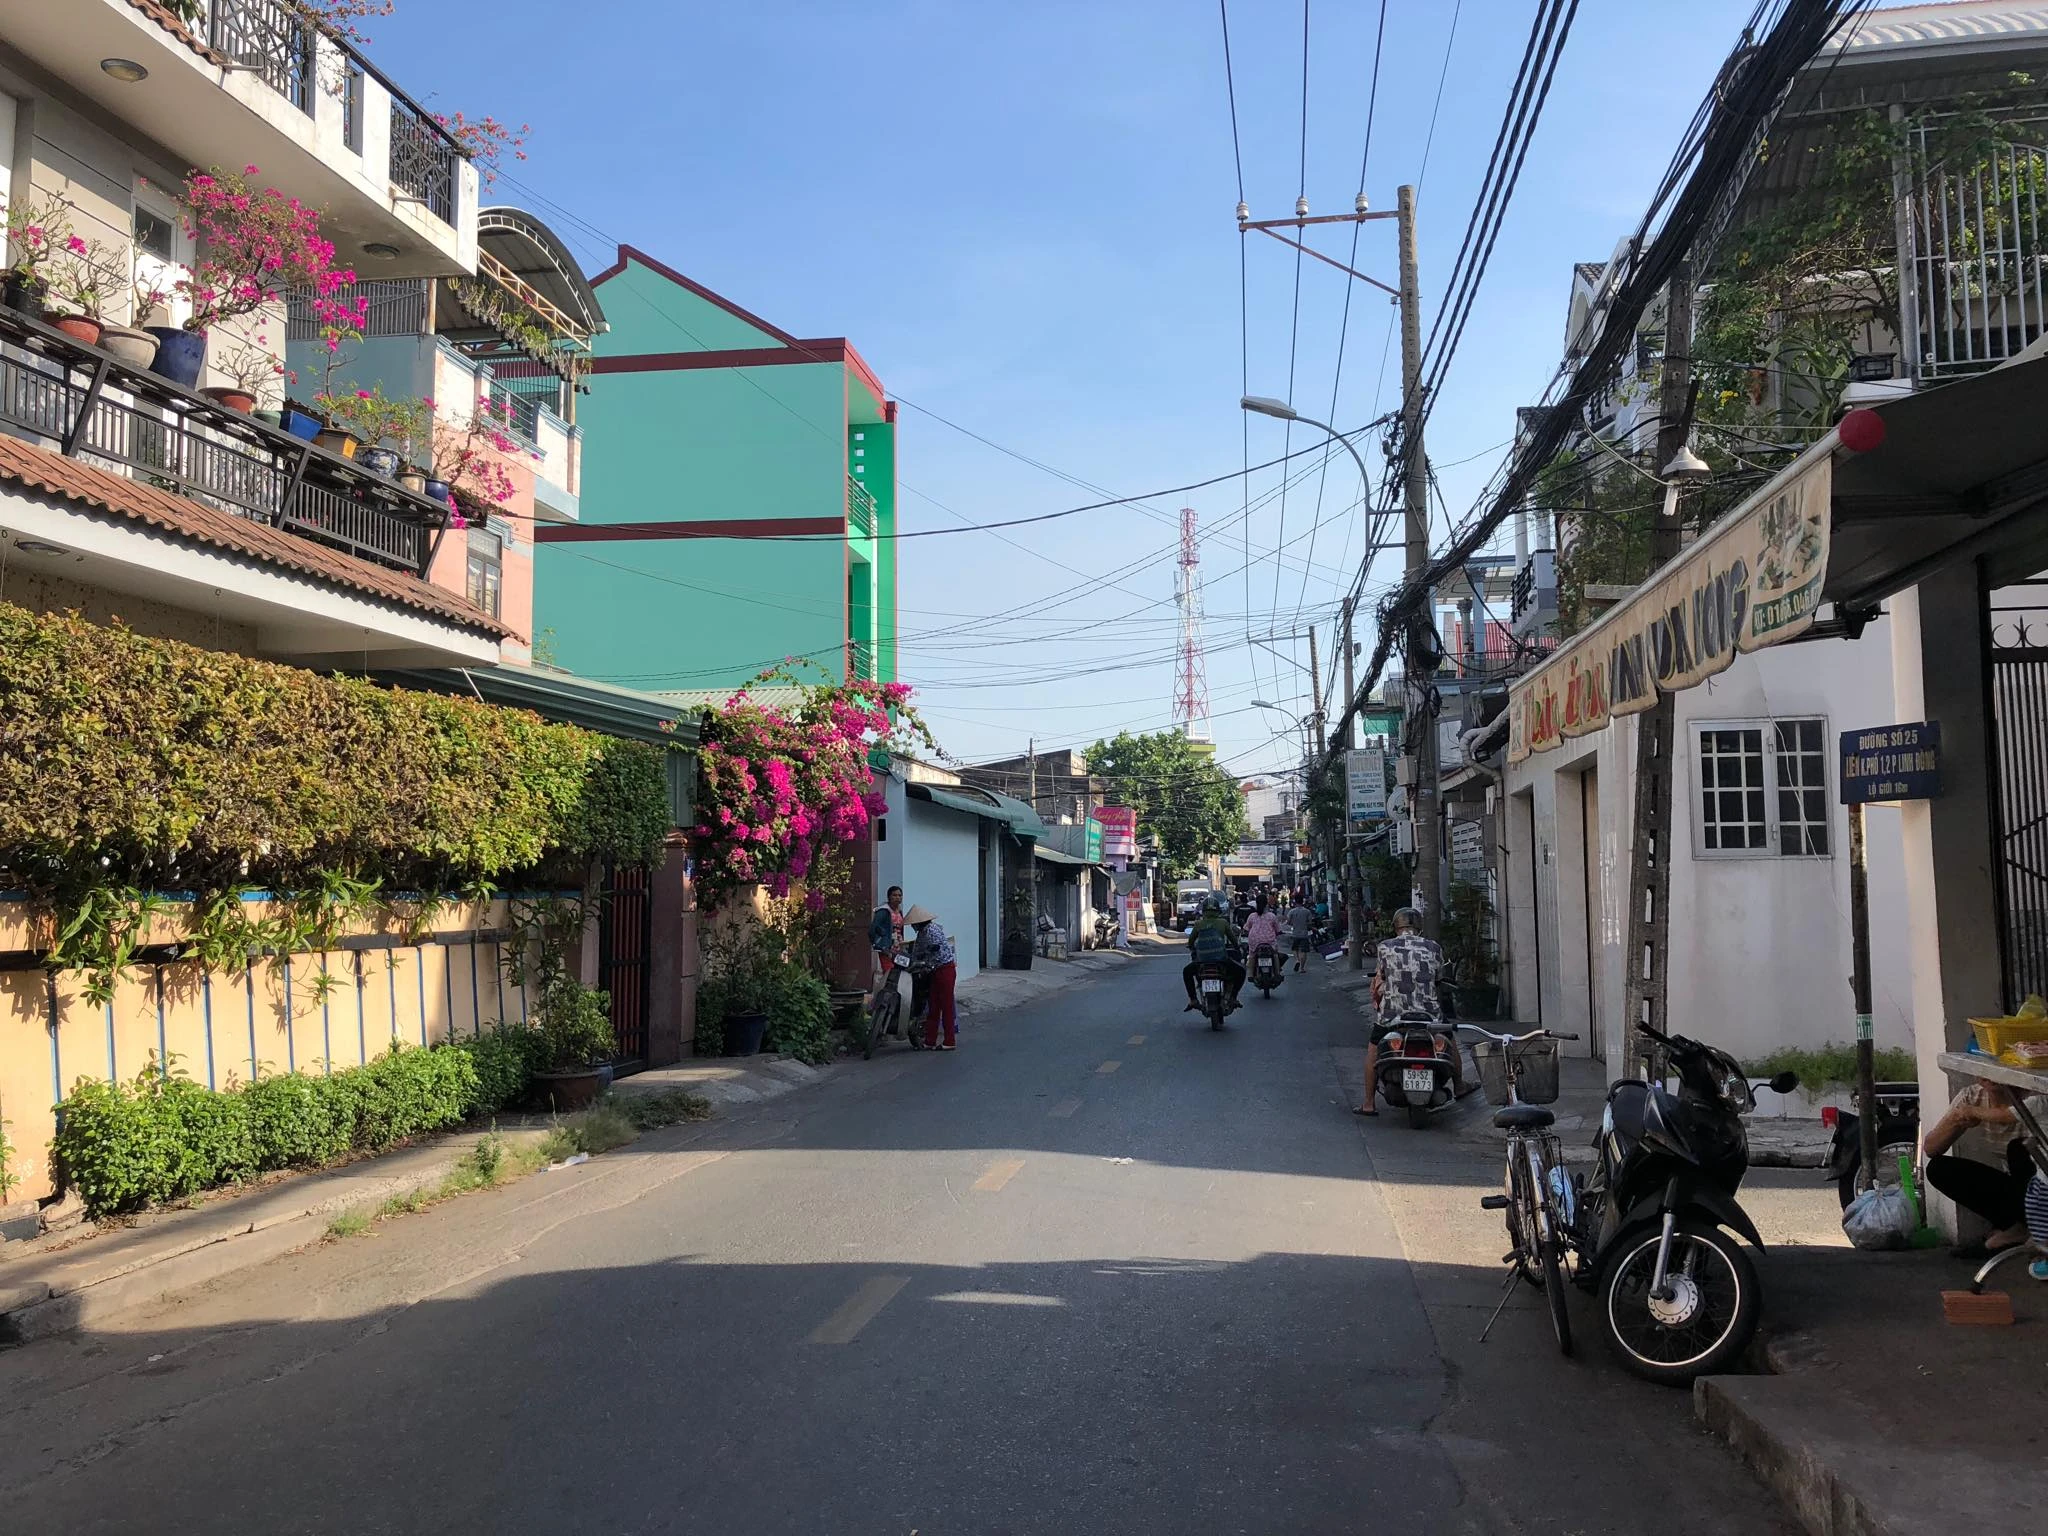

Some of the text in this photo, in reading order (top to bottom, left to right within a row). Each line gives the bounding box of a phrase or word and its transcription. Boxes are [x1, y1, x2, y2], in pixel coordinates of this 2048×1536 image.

[1859, 726, 1918, 750] ĐƯỜNG SỐ 25
[1898, 752, 1914, 773] LINH
